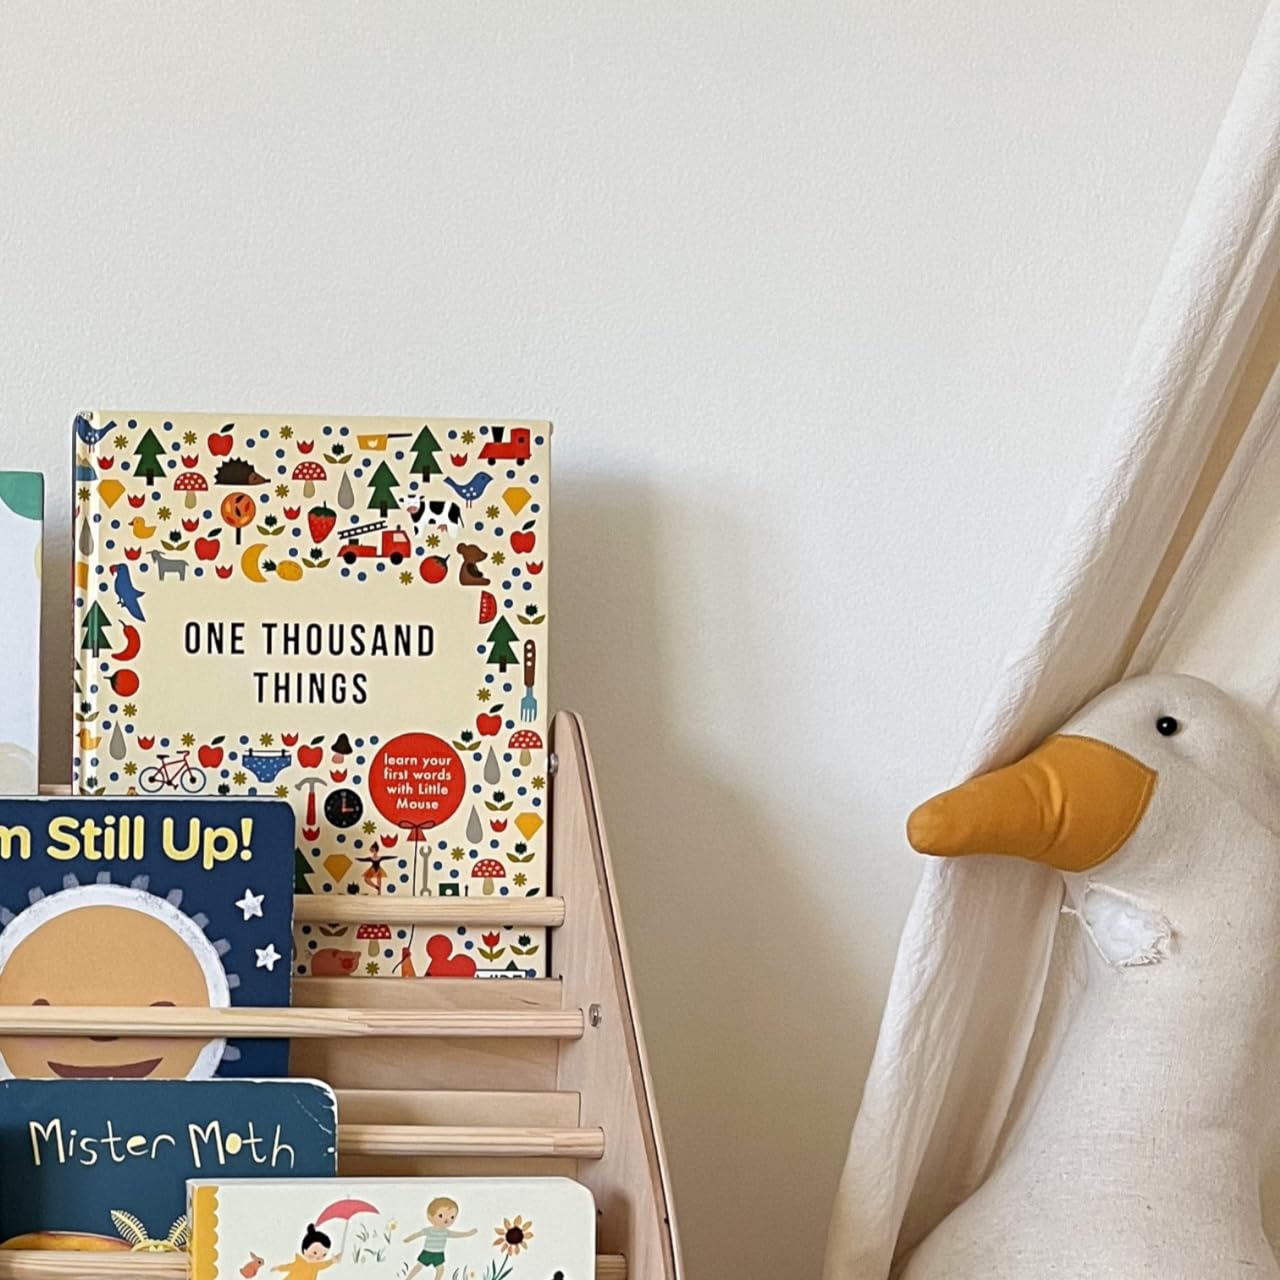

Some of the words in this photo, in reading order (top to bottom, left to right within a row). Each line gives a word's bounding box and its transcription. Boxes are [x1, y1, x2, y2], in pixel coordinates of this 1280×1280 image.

[184, 621, 245, 655] ONE
[261, 622, 434, 657] THOUSAND
[253, 672, 367, 705] THINGS
[384, 752, 418, 766] learn
[422, 757, 452, 769] your
[384, 766, 408, 780] first
[412, 766, 452, 781] words
[386, 782, 414, 795] with
[418, 782, 449, 795] Little
[396, 797, 439, 810] Mouse
[46, 814, 145, 861] Still
[162, 817, 254, 871] Up!
[27, 1118, 176, 1168] Mister
[188, 1120, 295, 1168] Moth
